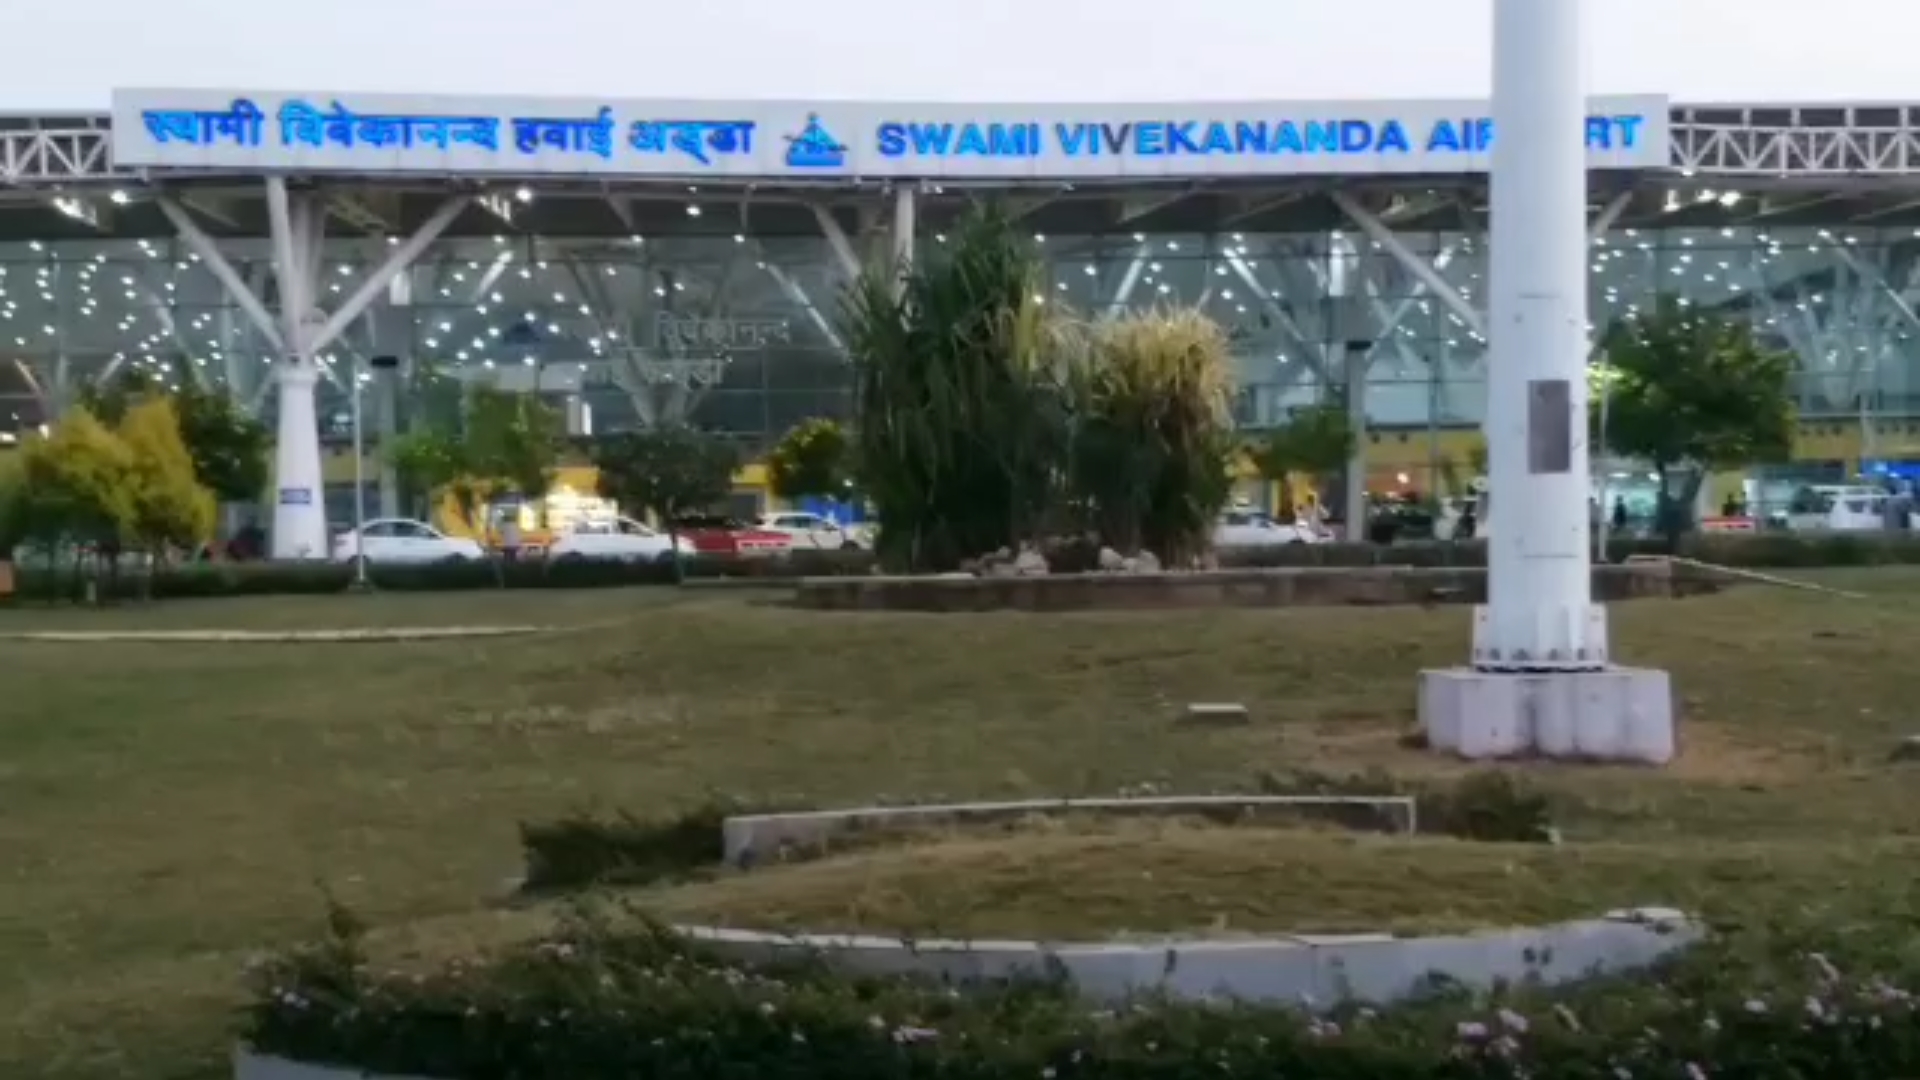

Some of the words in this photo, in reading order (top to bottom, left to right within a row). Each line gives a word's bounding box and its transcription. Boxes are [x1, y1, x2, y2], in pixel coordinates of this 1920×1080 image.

[141, 98, 266, 148] स्वामी
[511, 106, 618, 161] हवाई
[877, 122, 1042, 157] SWAMI
[1055, 121, 1411, 156] VIVEKANANDA
[1426, 115, 1642, 152] AIRRT
